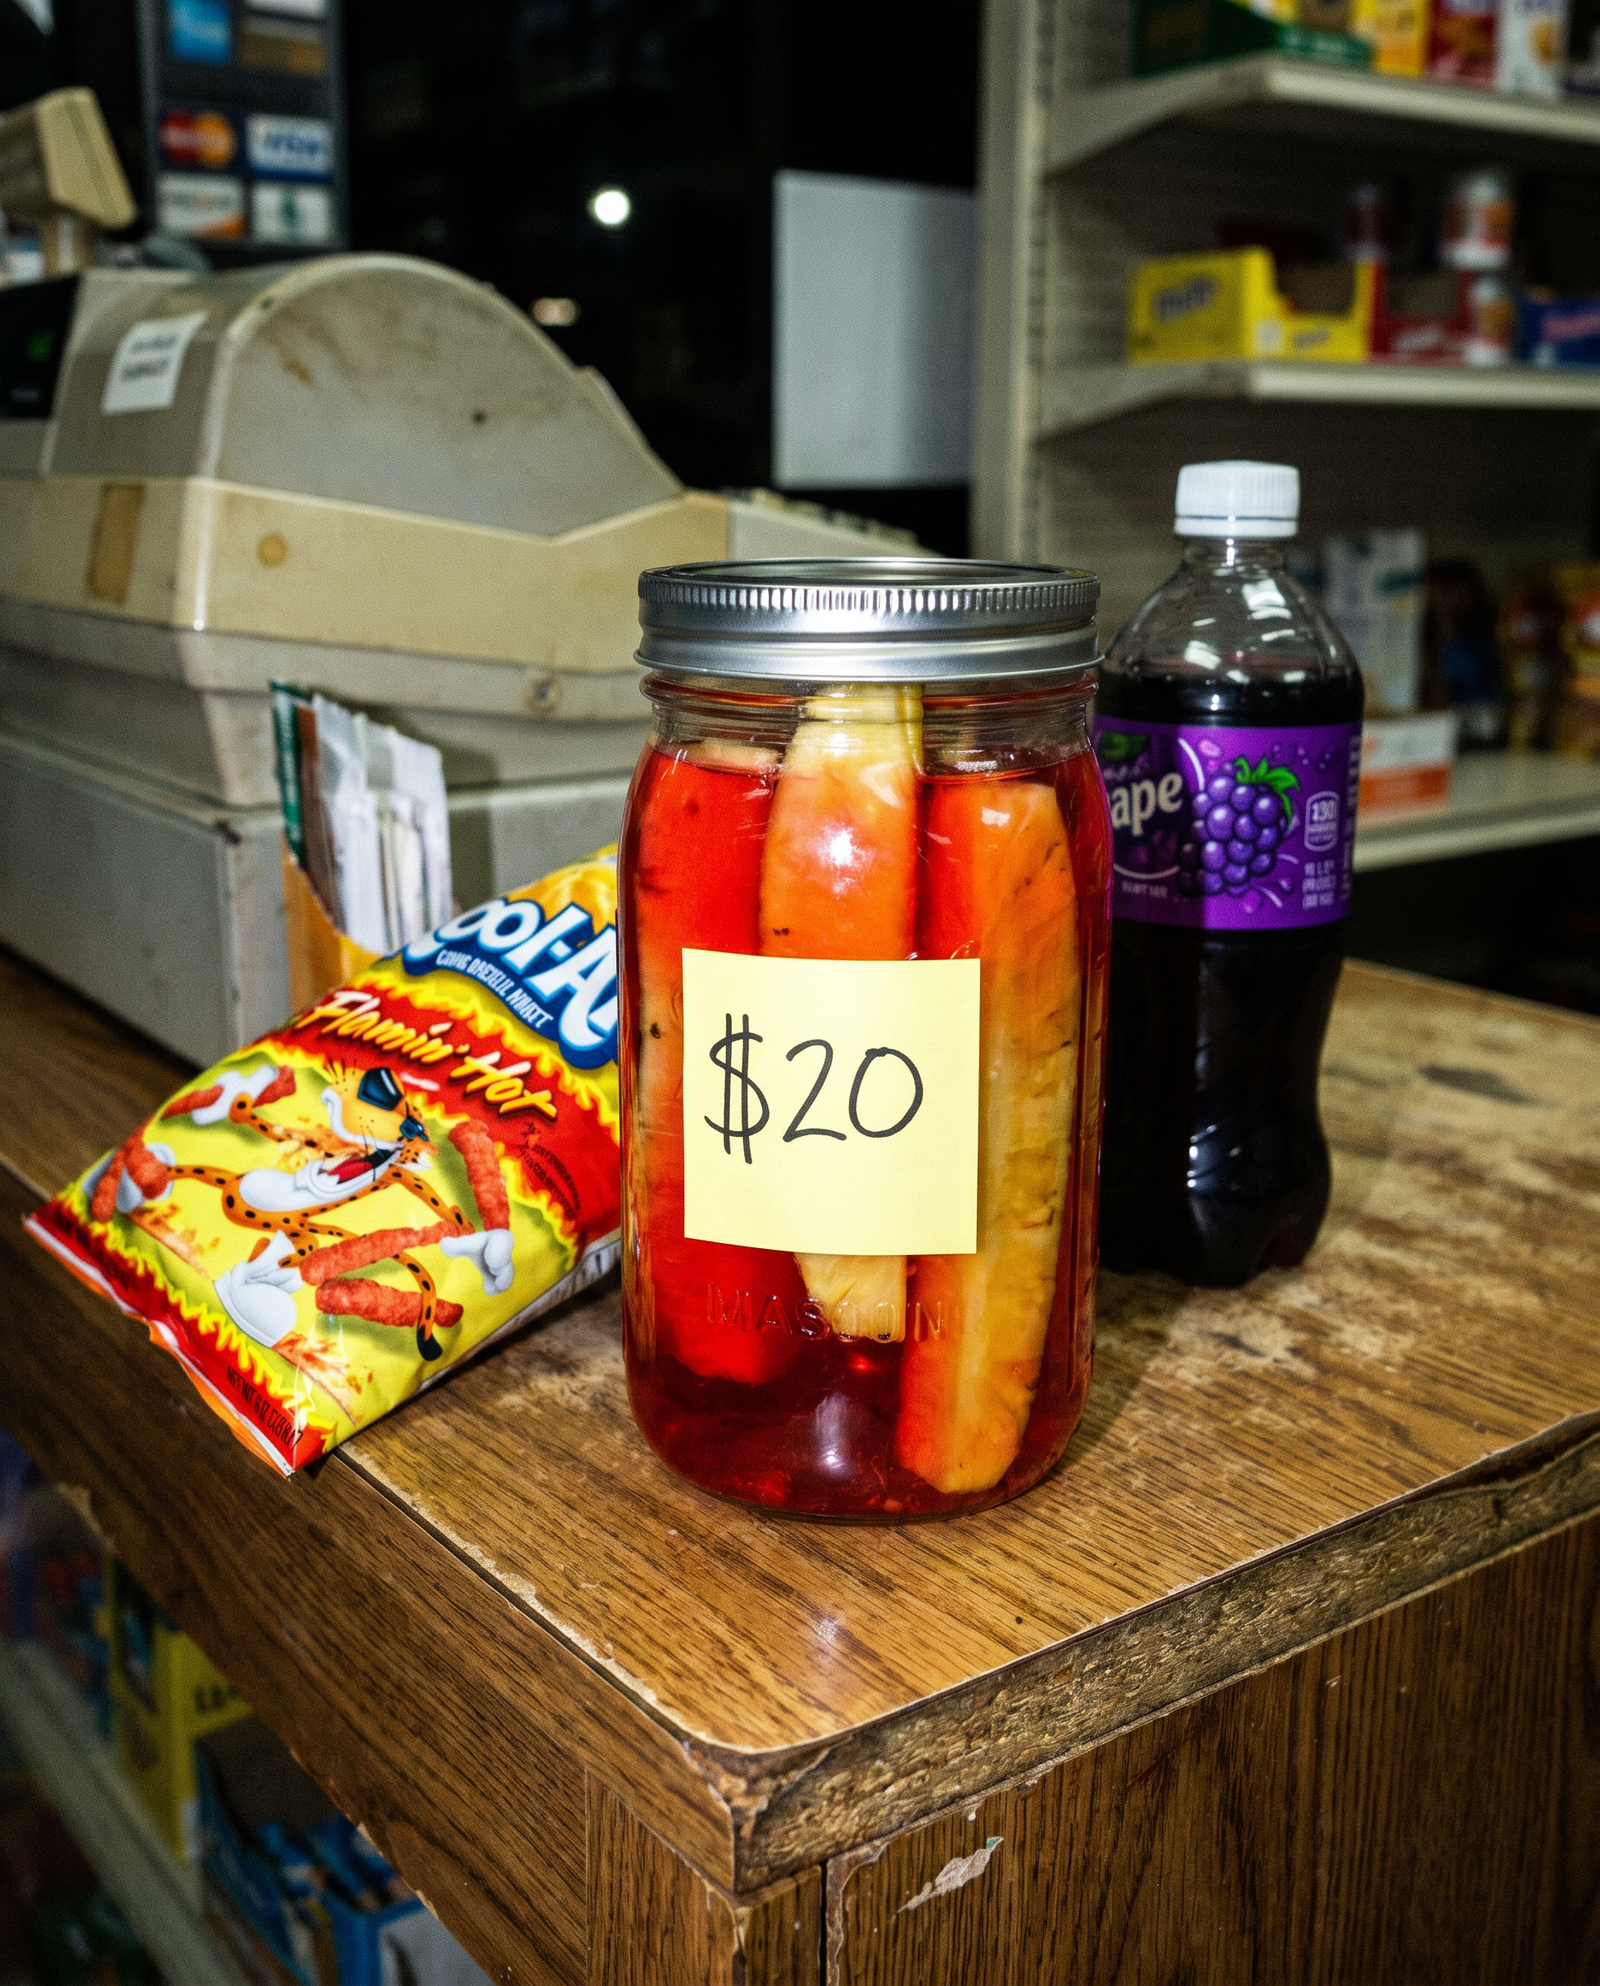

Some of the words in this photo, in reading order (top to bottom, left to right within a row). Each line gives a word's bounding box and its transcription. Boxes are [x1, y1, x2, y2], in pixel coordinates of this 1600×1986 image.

[1111, 772, 1183, 837] ape
[294, 991, 470, 1064] Flamin'
[404, 898, 618, 1050] ool-A
[704, 1013, 923, 1165] $20
